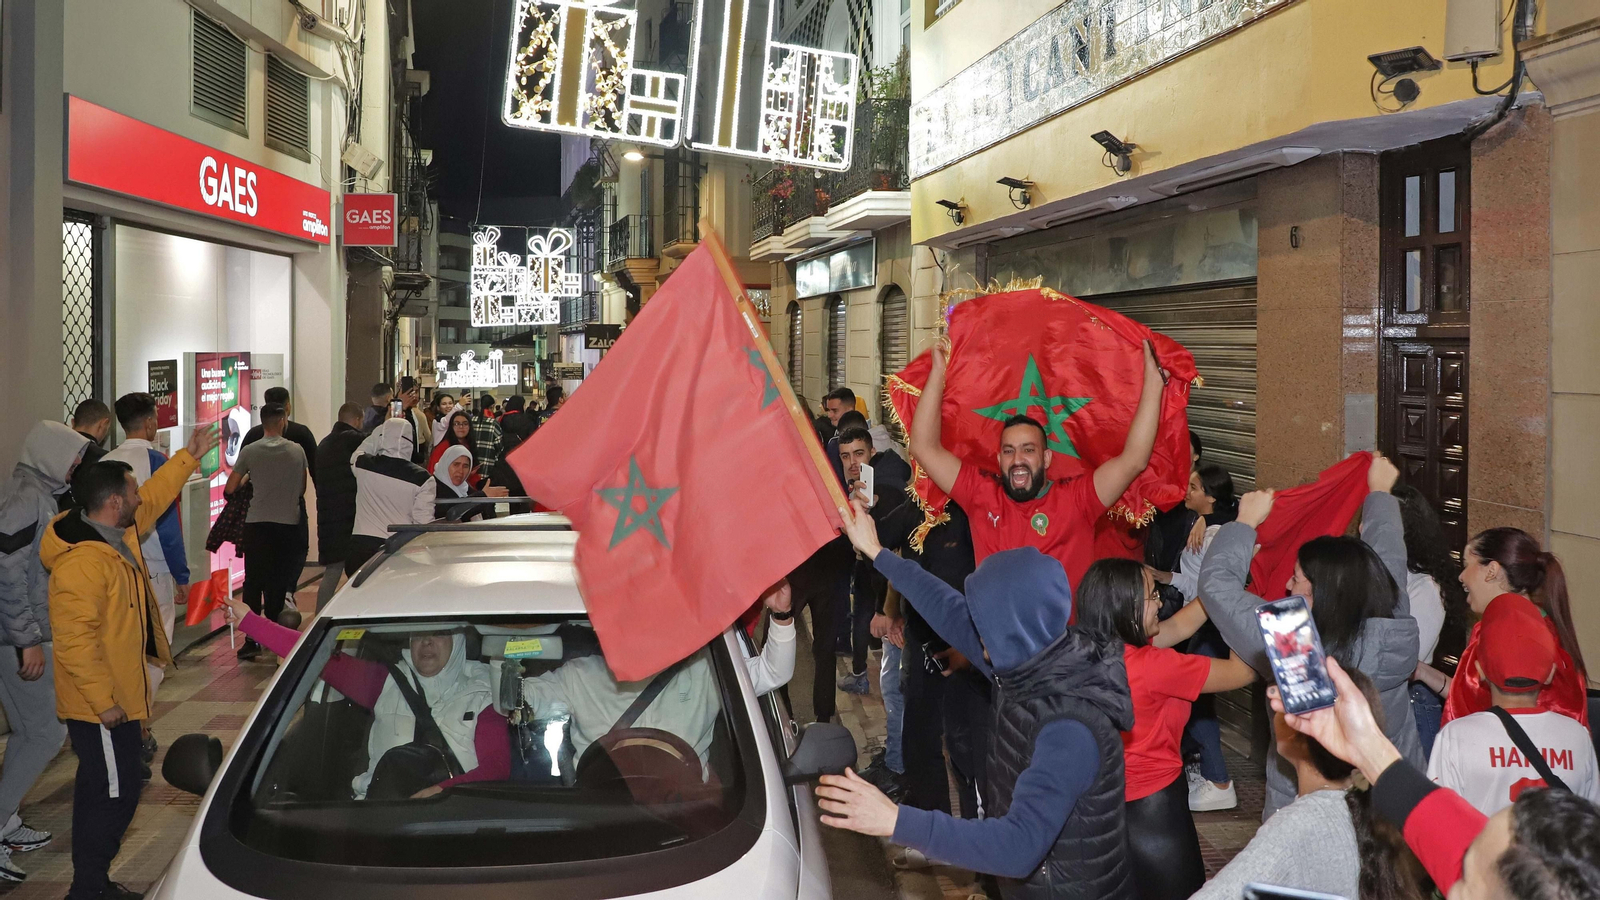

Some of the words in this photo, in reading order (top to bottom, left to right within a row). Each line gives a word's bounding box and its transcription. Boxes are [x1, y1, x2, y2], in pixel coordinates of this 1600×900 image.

[199, 155, 258, 217] GAES
[346, 209, 391, 224] GAES
[302, 219, 328, 237] amplifon
[1290, 225, 1299, 248] 6
[150, 378, 169, 392] Black
